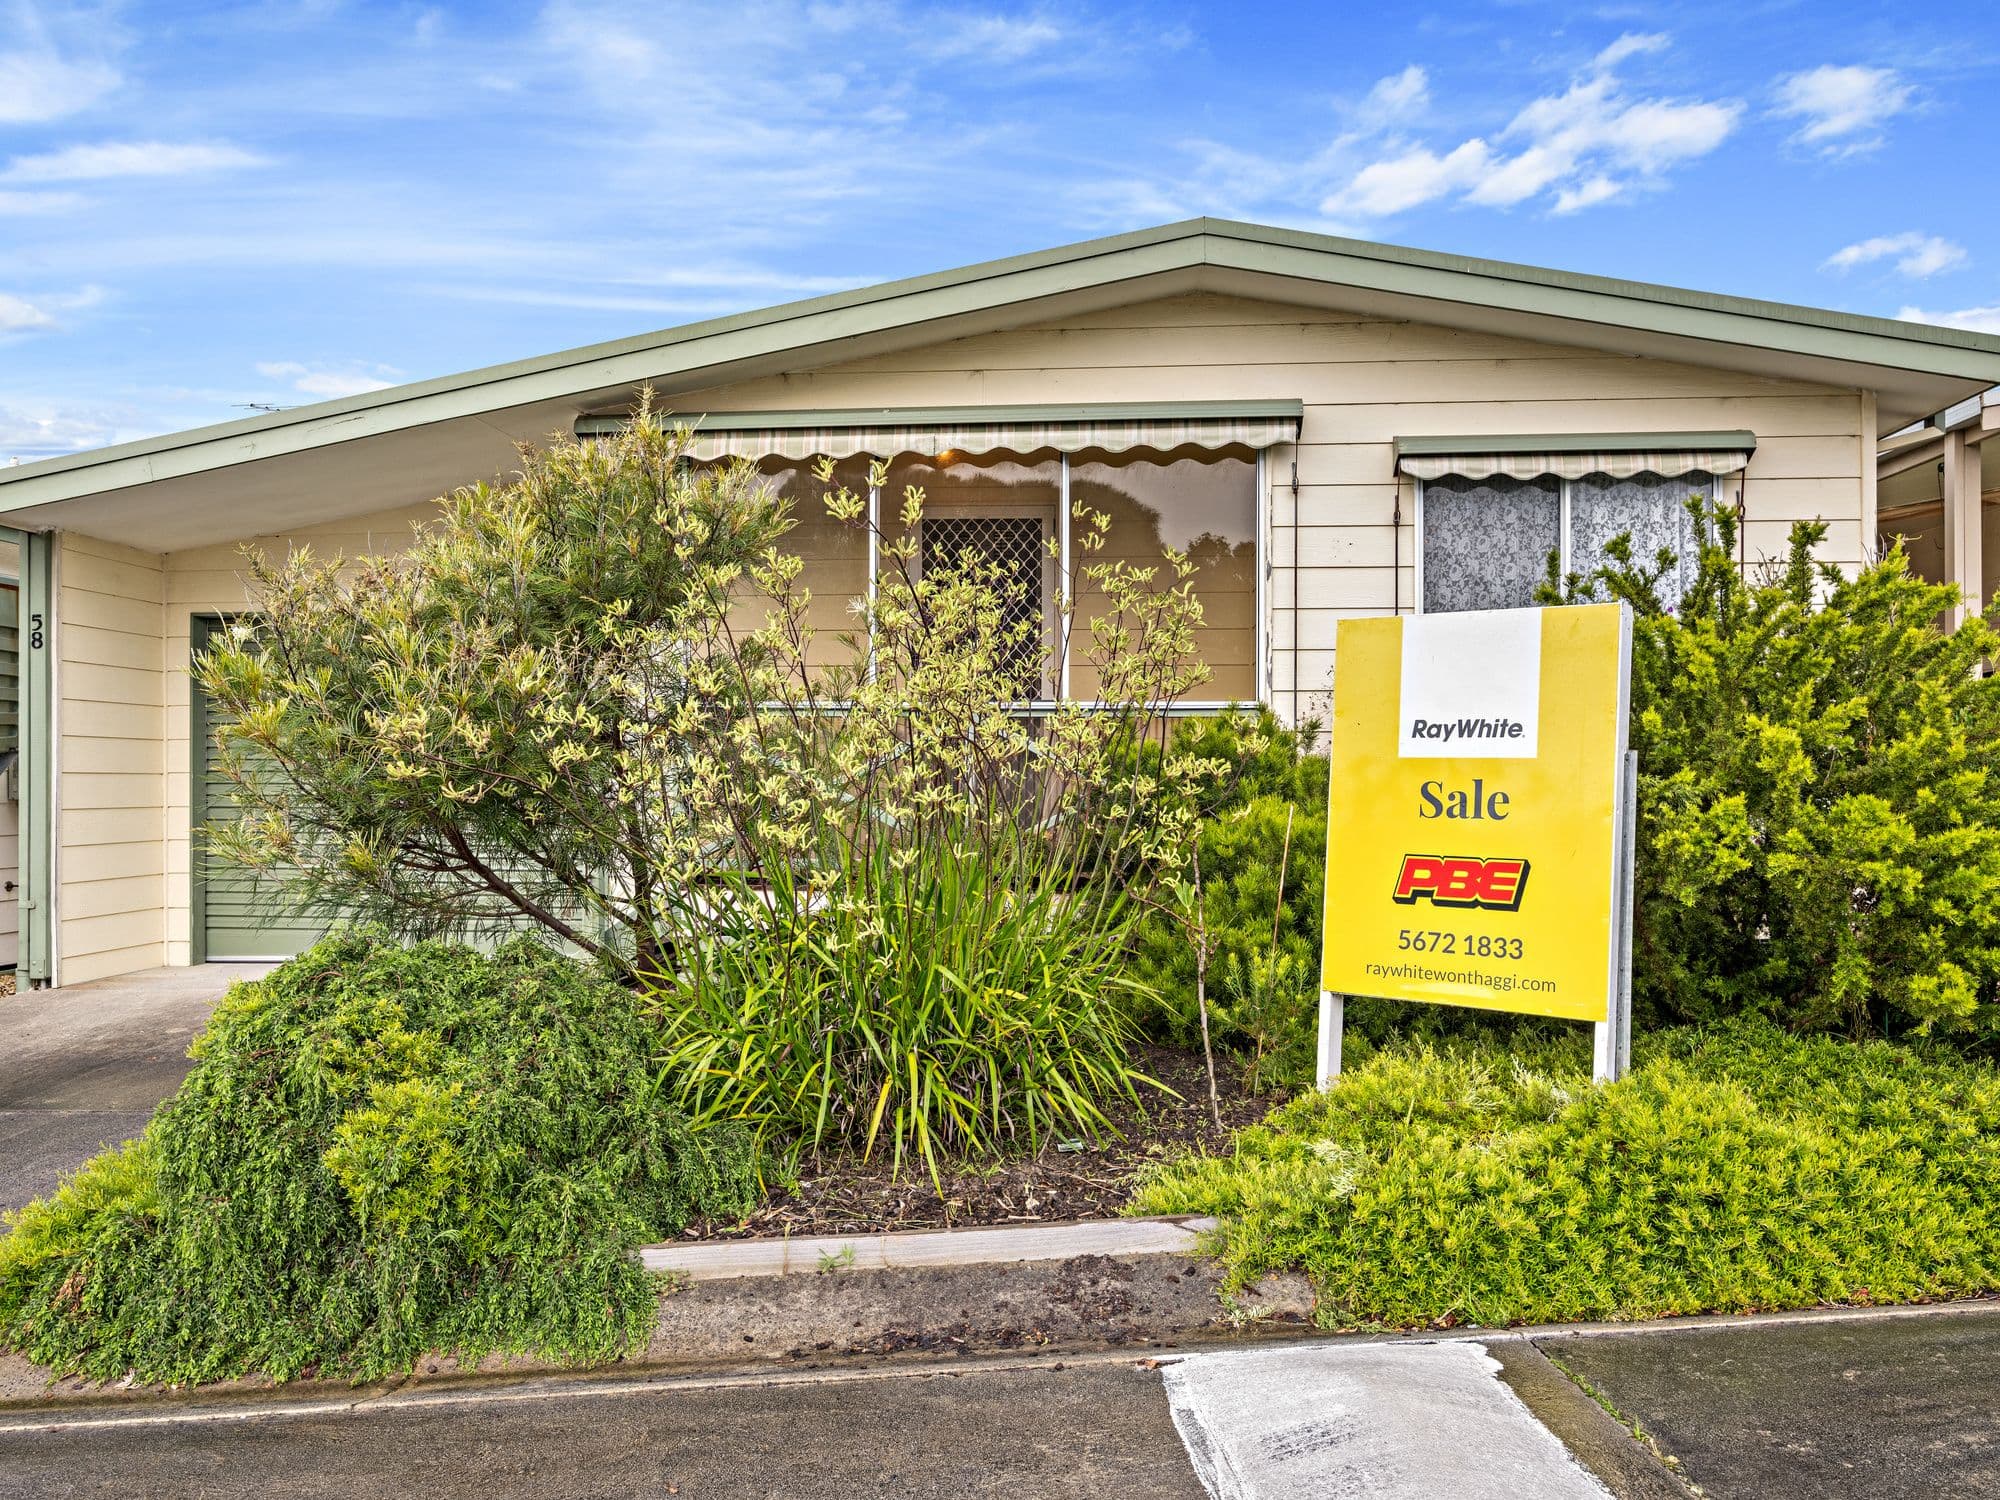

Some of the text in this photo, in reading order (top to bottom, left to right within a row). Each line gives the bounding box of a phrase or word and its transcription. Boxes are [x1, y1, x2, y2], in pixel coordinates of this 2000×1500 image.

[32, 614, 43, 649] 58
[1419, 779, 1510, 820] Sale
[1393, 854, 1531, 912] PBE
[1398, 930, 1524, 960] 5672 1833
[1366, 964, 1557, 993] raywhitewonthaggi.com
